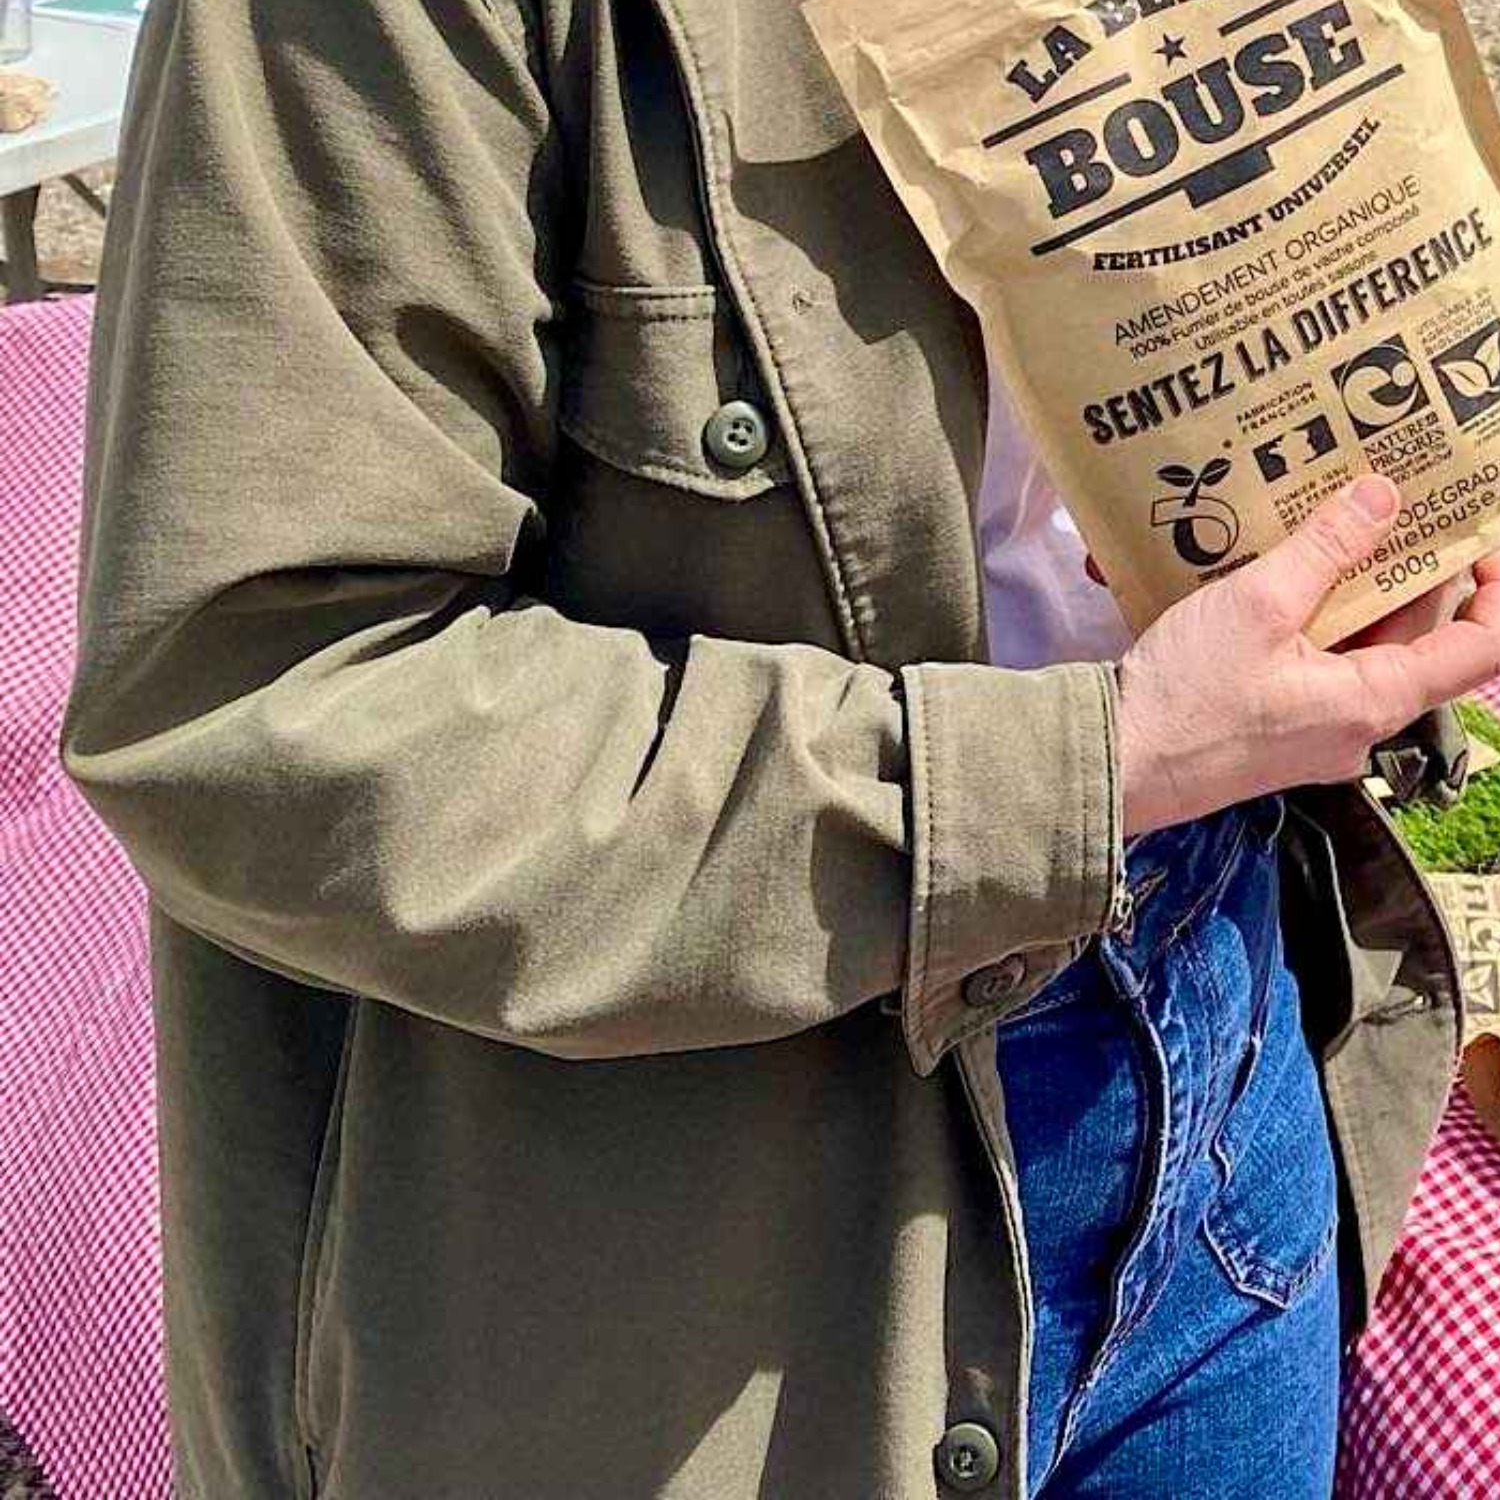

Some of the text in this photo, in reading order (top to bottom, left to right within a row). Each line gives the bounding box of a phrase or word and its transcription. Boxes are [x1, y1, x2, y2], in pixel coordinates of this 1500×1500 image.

[1006, 25, 1093, 103] LA
[1024, 0, 1365, 219] BOUSE
[1093, 116, 1381, 271] FERTILISANT UNIVERSEL
[1115, 174, 1421, 345] AMENDEMENT ORGANIQUE
[1130, 334, 1172, 360] 100%
[1172, 312, 1220, 342] Fumier
[1223, 299, 1243, 320] de
[1245, 274, 1290, 307] bouse
[1292, 265, 1312, 282] de
[1313, 243, 1354, 271] vache
[1195, 313, 1259, 350] Utilisable
[1262, 302, 1280, 318] en
[1282, 280, 1326, 309] toutes
[1083, 207, 1493, 445] SENTEZ LA DIFFERENCE
[1236, 382, 1312, 423] FABRICATION
[1375, 549, 1440, 593] 500g
